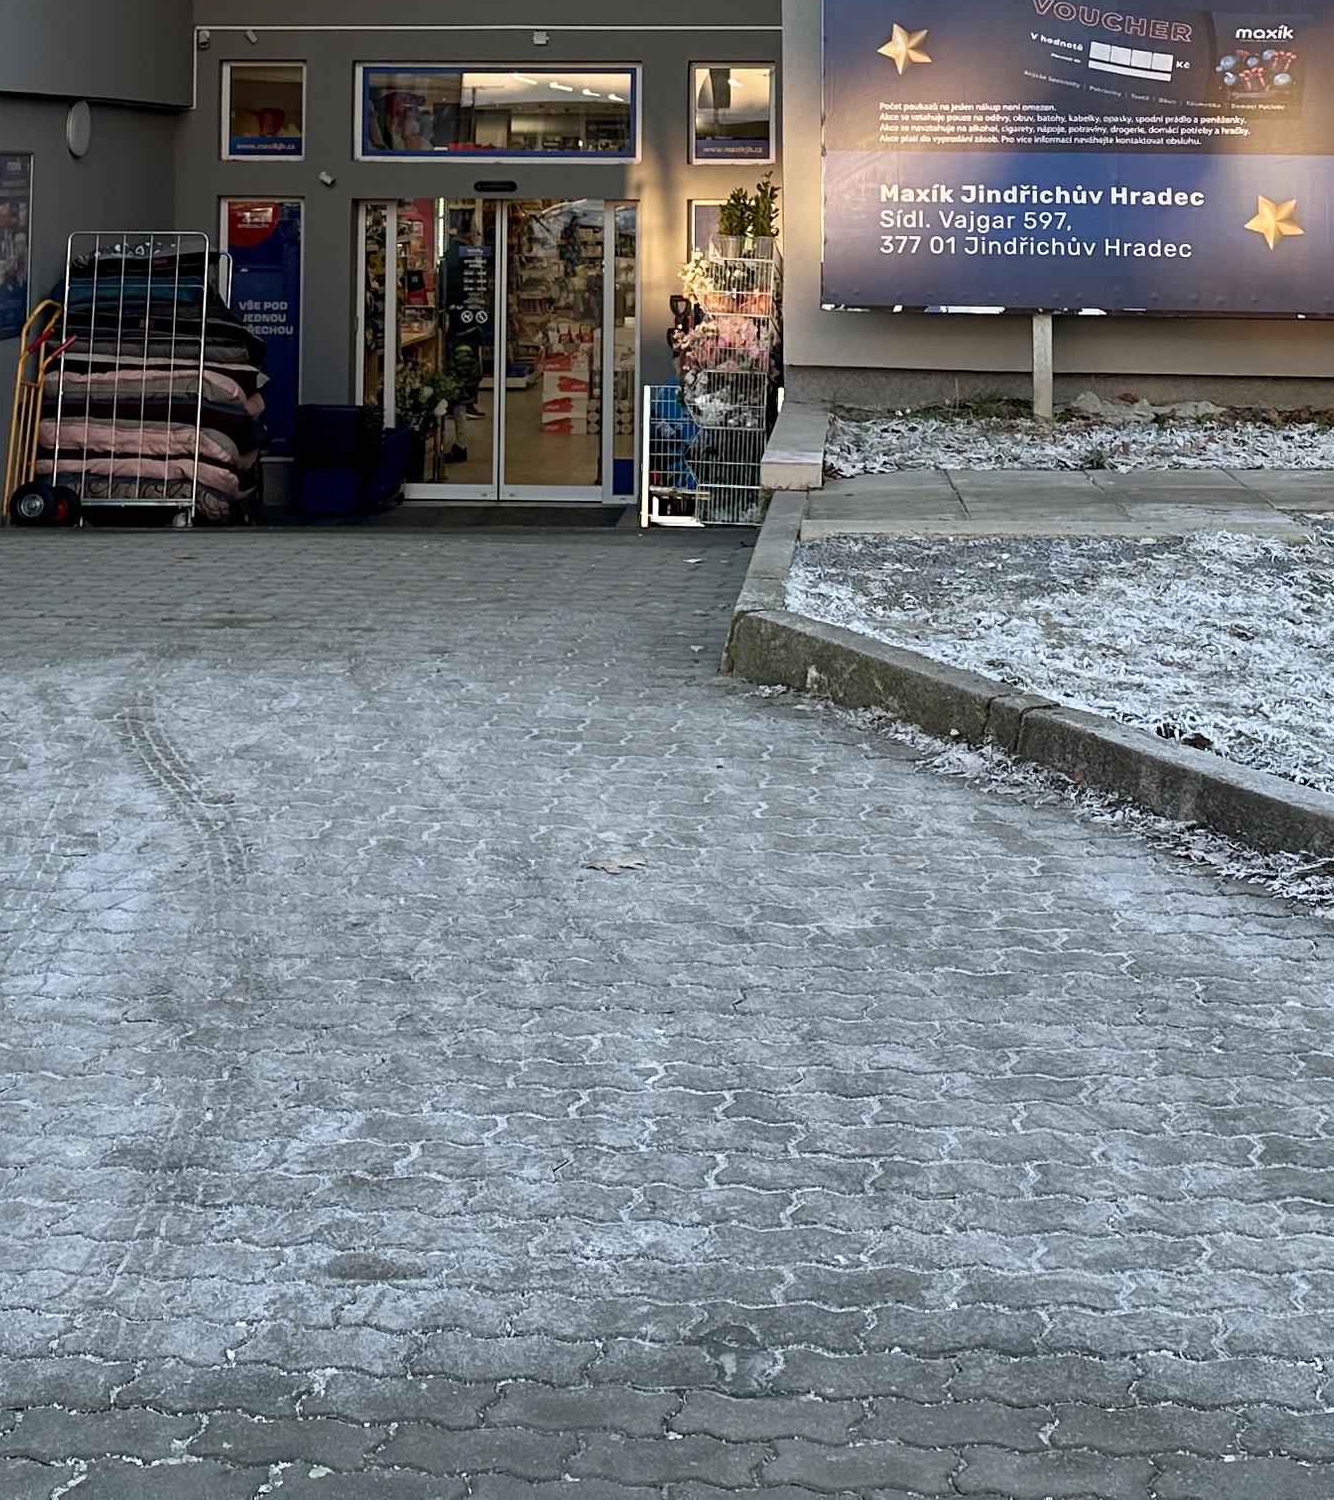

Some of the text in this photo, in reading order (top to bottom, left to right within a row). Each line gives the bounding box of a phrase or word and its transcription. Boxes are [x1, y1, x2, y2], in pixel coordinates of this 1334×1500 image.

[1235, 24, 1294, 39] maxík
[1040, 34, 1084, 51] hodnotě
[1176, 60, 1191, 69] Kč
[879, 184, 1205, 206] Maxík Jindřichův Hradec
[879, 209, 1073, 233] Sídl. Vajgar 597,
[879, 235, 1193, 258] 377 01 Jindřichův Hradec
[239, 300, 288, 311] VŠE POD
[242, 313, 287, 323] JEDNOU
